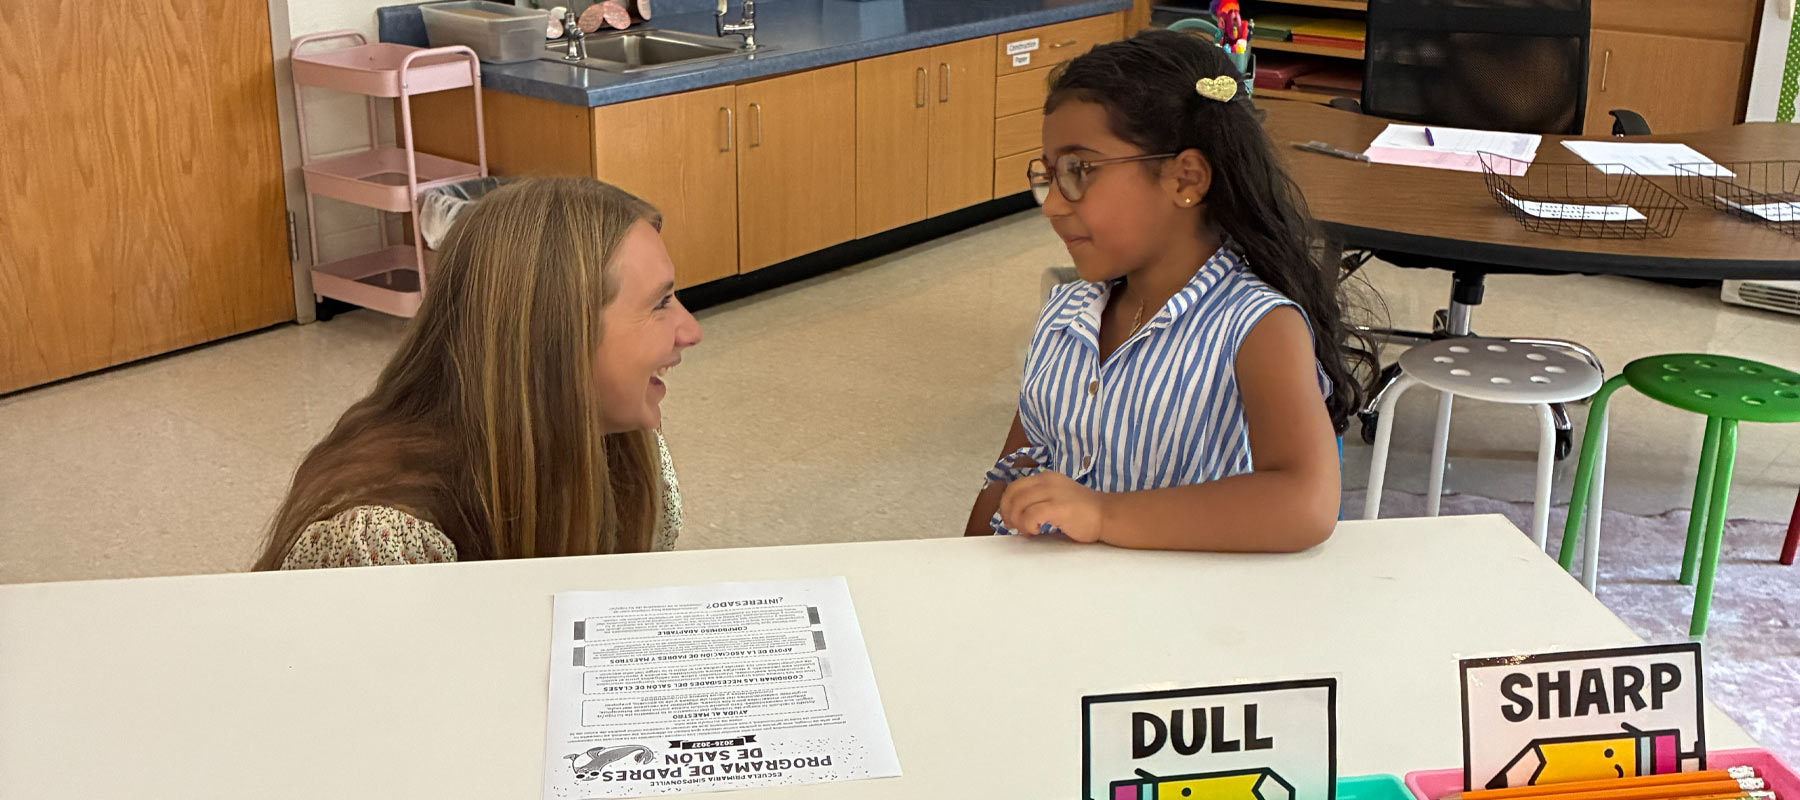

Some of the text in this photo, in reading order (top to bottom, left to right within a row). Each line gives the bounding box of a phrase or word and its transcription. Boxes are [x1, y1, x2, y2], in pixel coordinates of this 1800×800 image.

[706, 597, 784, 609] ¿INTERESADO?
[690, 678, 741, 687] NECESIDADES
[759, 675, 803, 683] COORDINAR
[1500, 662, 1682, 724] SHARP
[1131, 704, 1273, 760] DULL
[692, 740, 734, 748] 2026-2027
[664, 748, 762, 767] DE SALÓN
[602, 756, 832, 782] PROGRAMA DE PADRES
[650, 772, 782, 786] ESCUELA PRIMARIA SIMPSONVILLE
